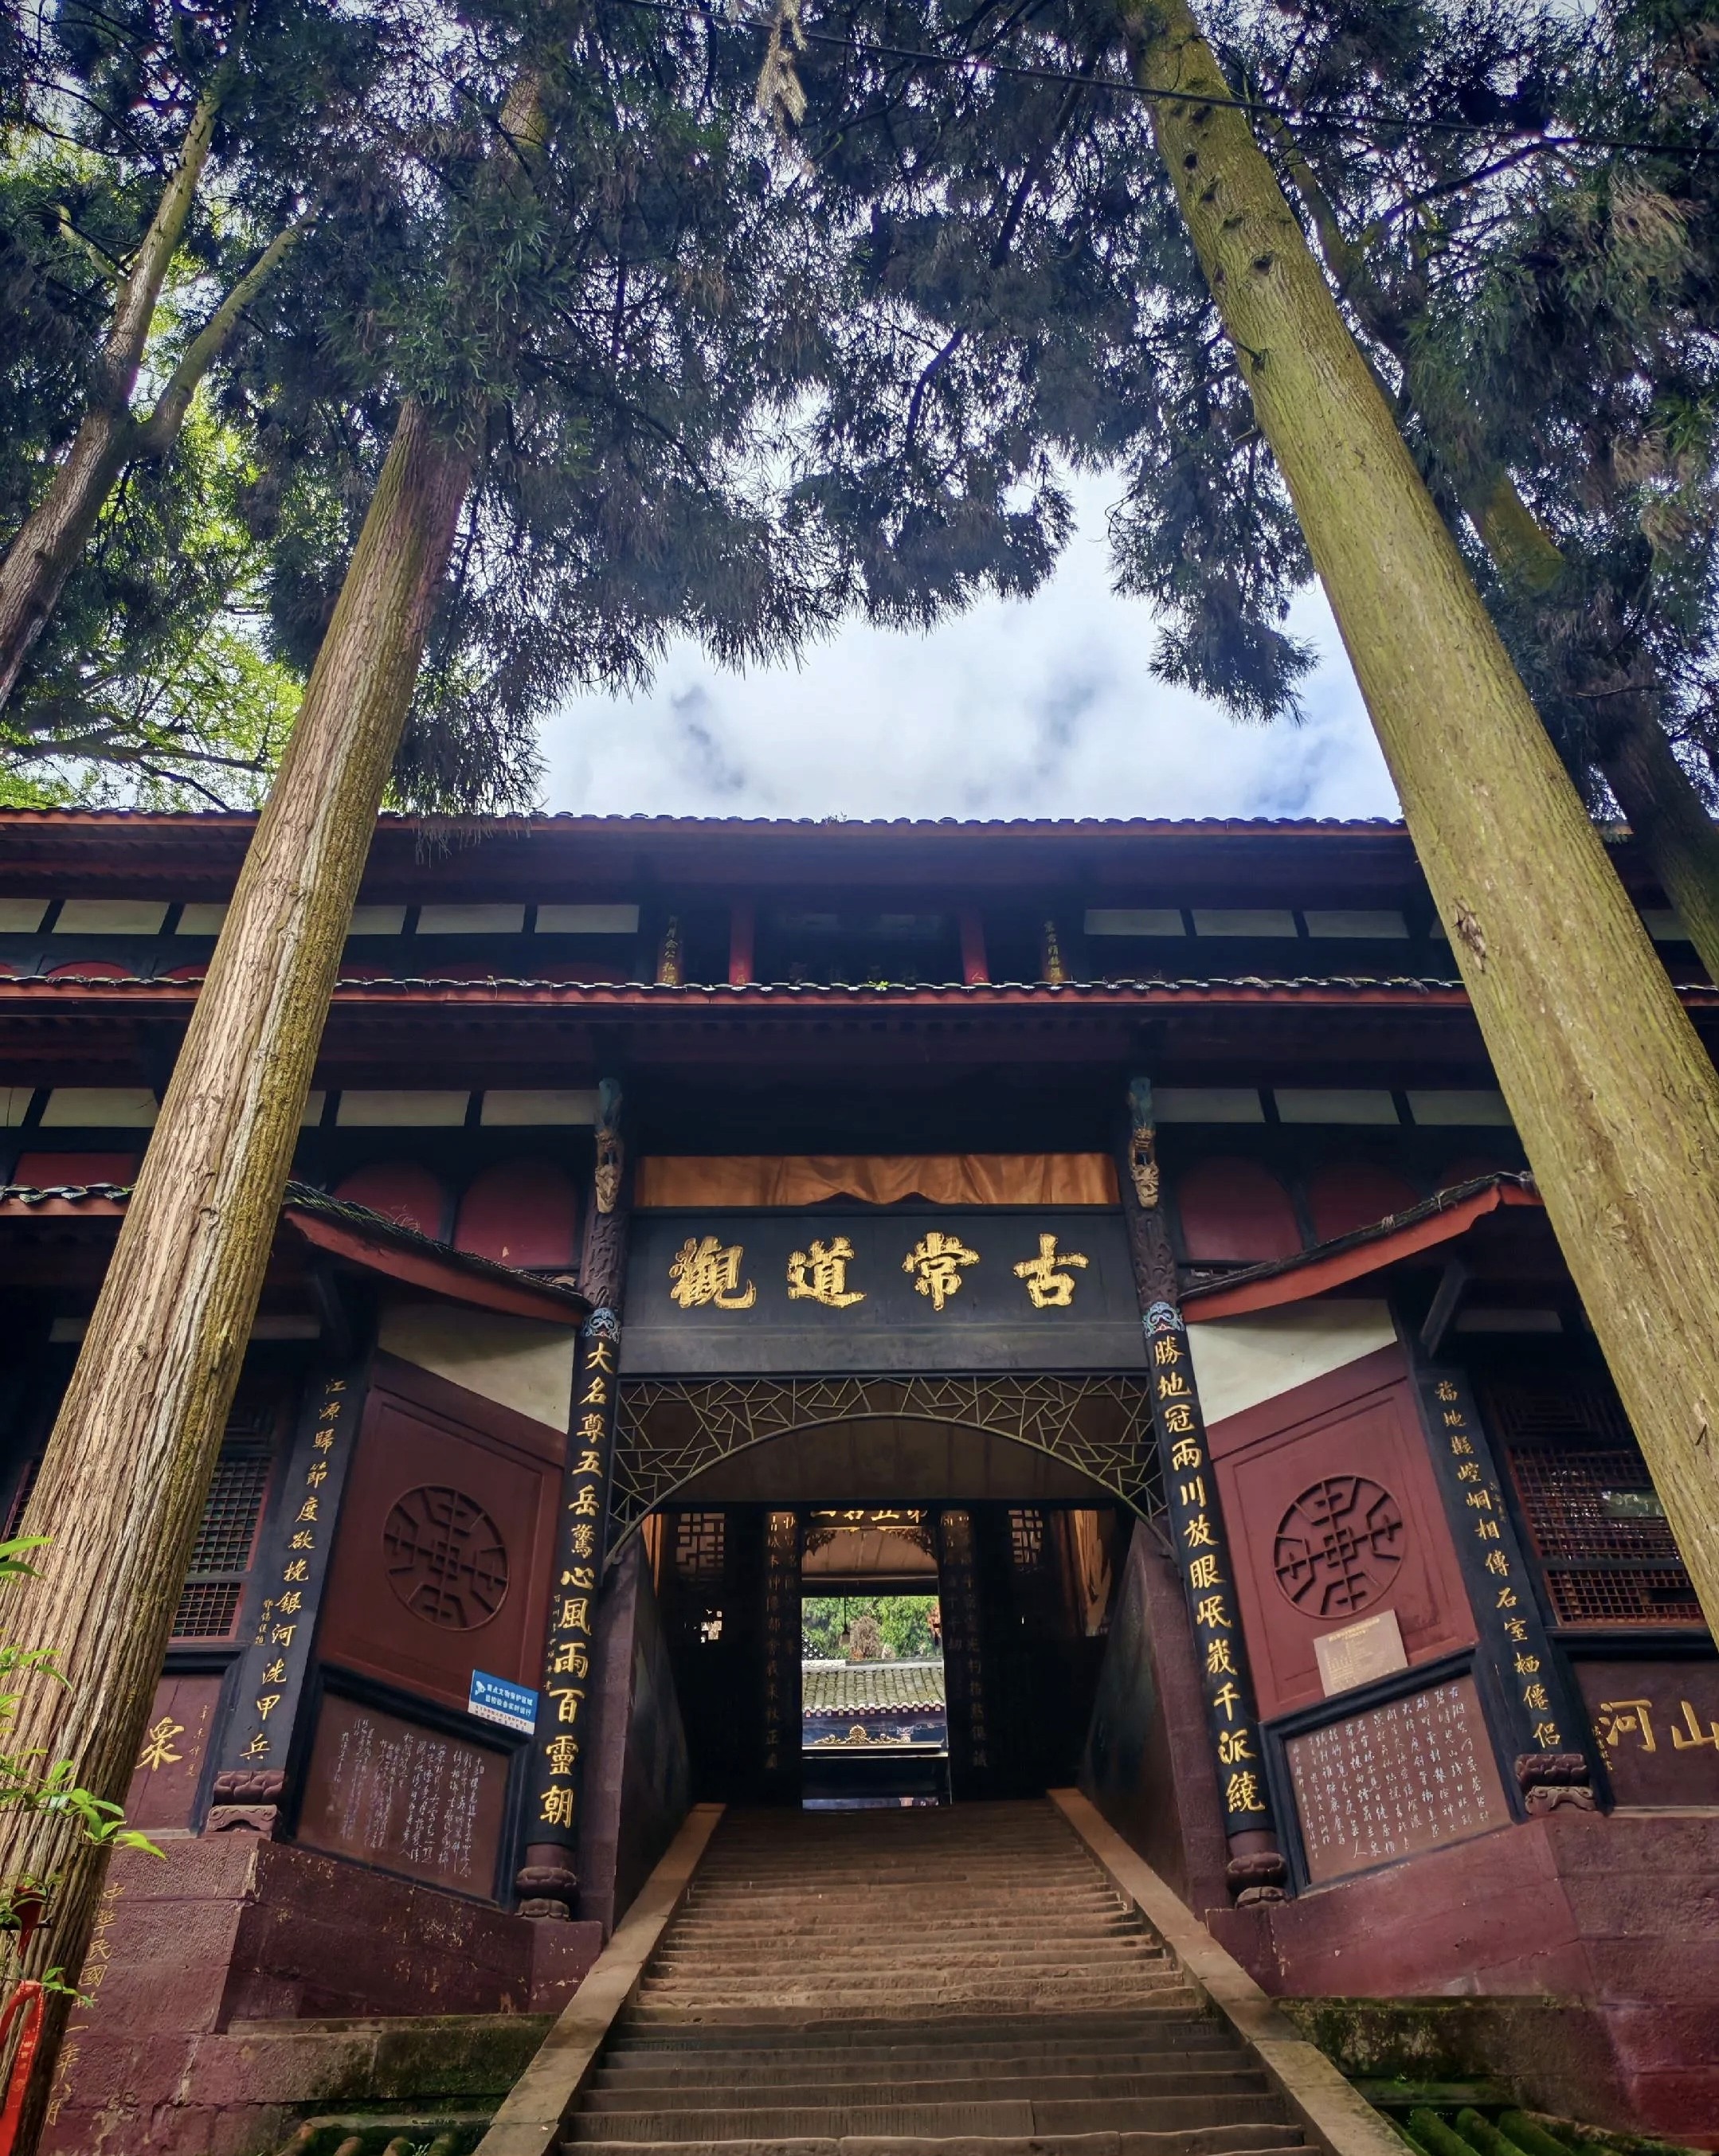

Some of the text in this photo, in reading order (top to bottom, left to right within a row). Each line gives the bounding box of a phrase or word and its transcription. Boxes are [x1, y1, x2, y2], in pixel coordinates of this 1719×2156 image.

[539, 1342, 613, 1828] 大名尊五岳驚心風雨百靈朝
